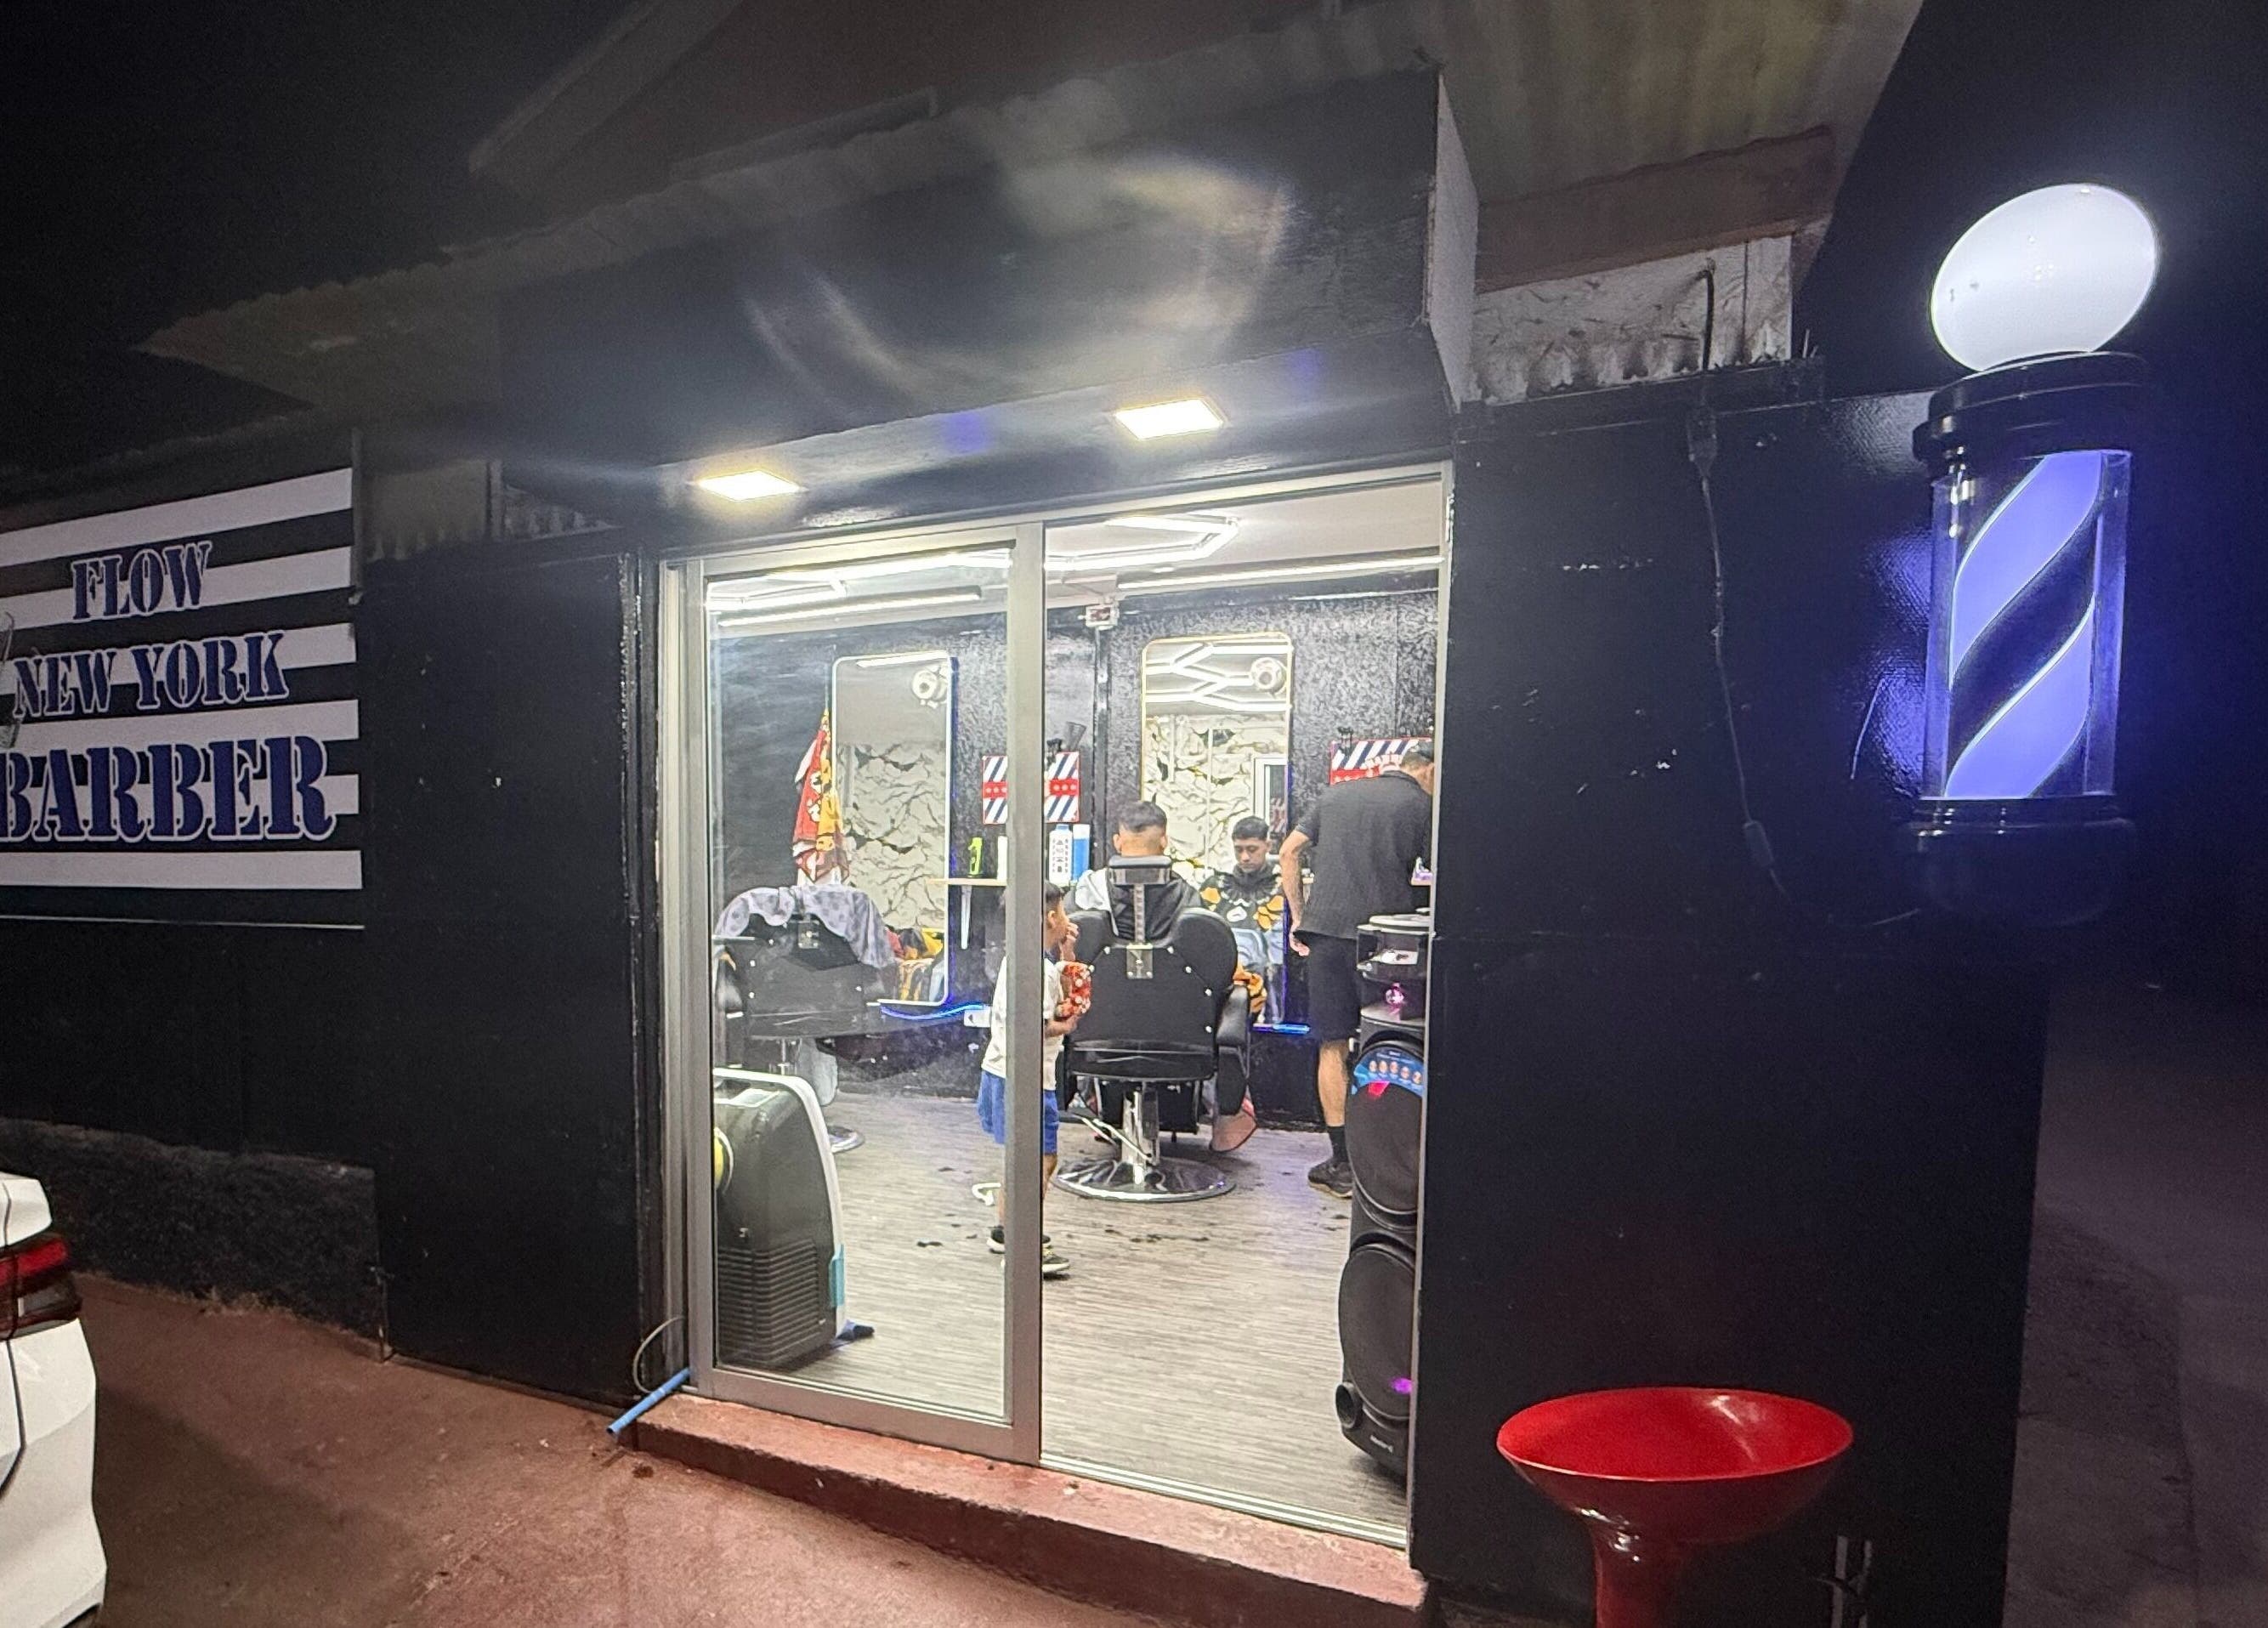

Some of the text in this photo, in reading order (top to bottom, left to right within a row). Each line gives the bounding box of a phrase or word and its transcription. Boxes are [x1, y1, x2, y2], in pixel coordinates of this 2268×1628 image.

[71, 541, 212, 621] FLOW
[13, 630, 289, 718] NEW YORK
[0, 735, 337, 842] BARBER
